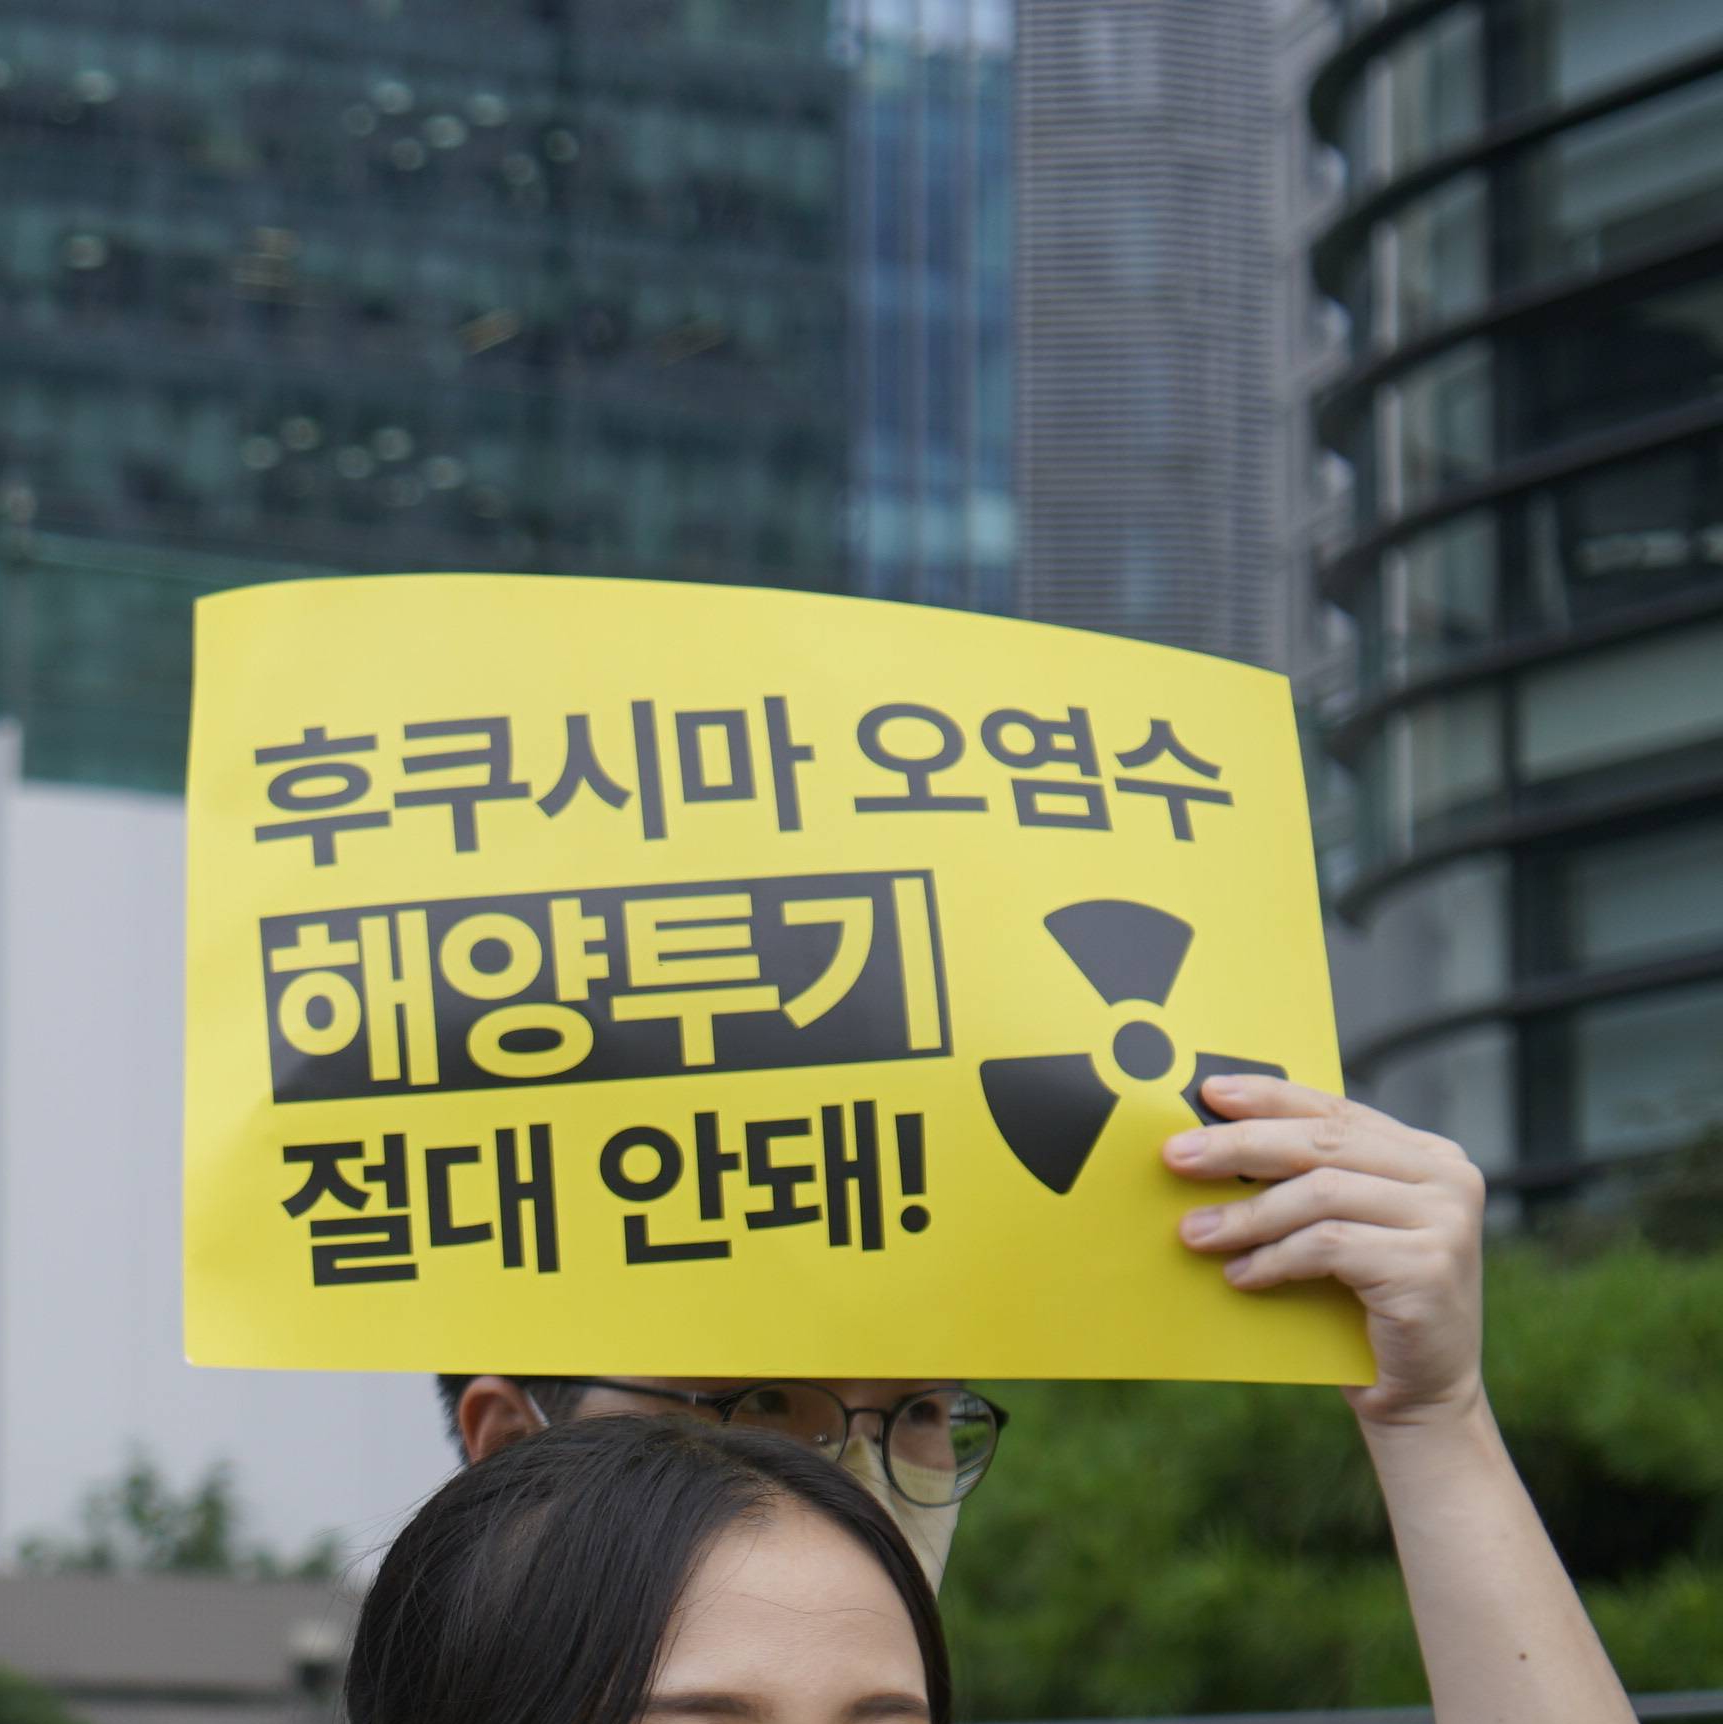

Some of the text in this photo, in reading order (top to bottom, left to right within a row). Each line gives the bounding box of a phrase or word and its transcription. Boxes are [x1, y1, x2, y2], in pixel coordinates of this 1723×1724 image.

[254, 696, 1235, 867] 후쿠시마 오염수
[268, 877, 943, 1087] 해양투기
[282, 1100, 932, 1287] 절대 안돼!
